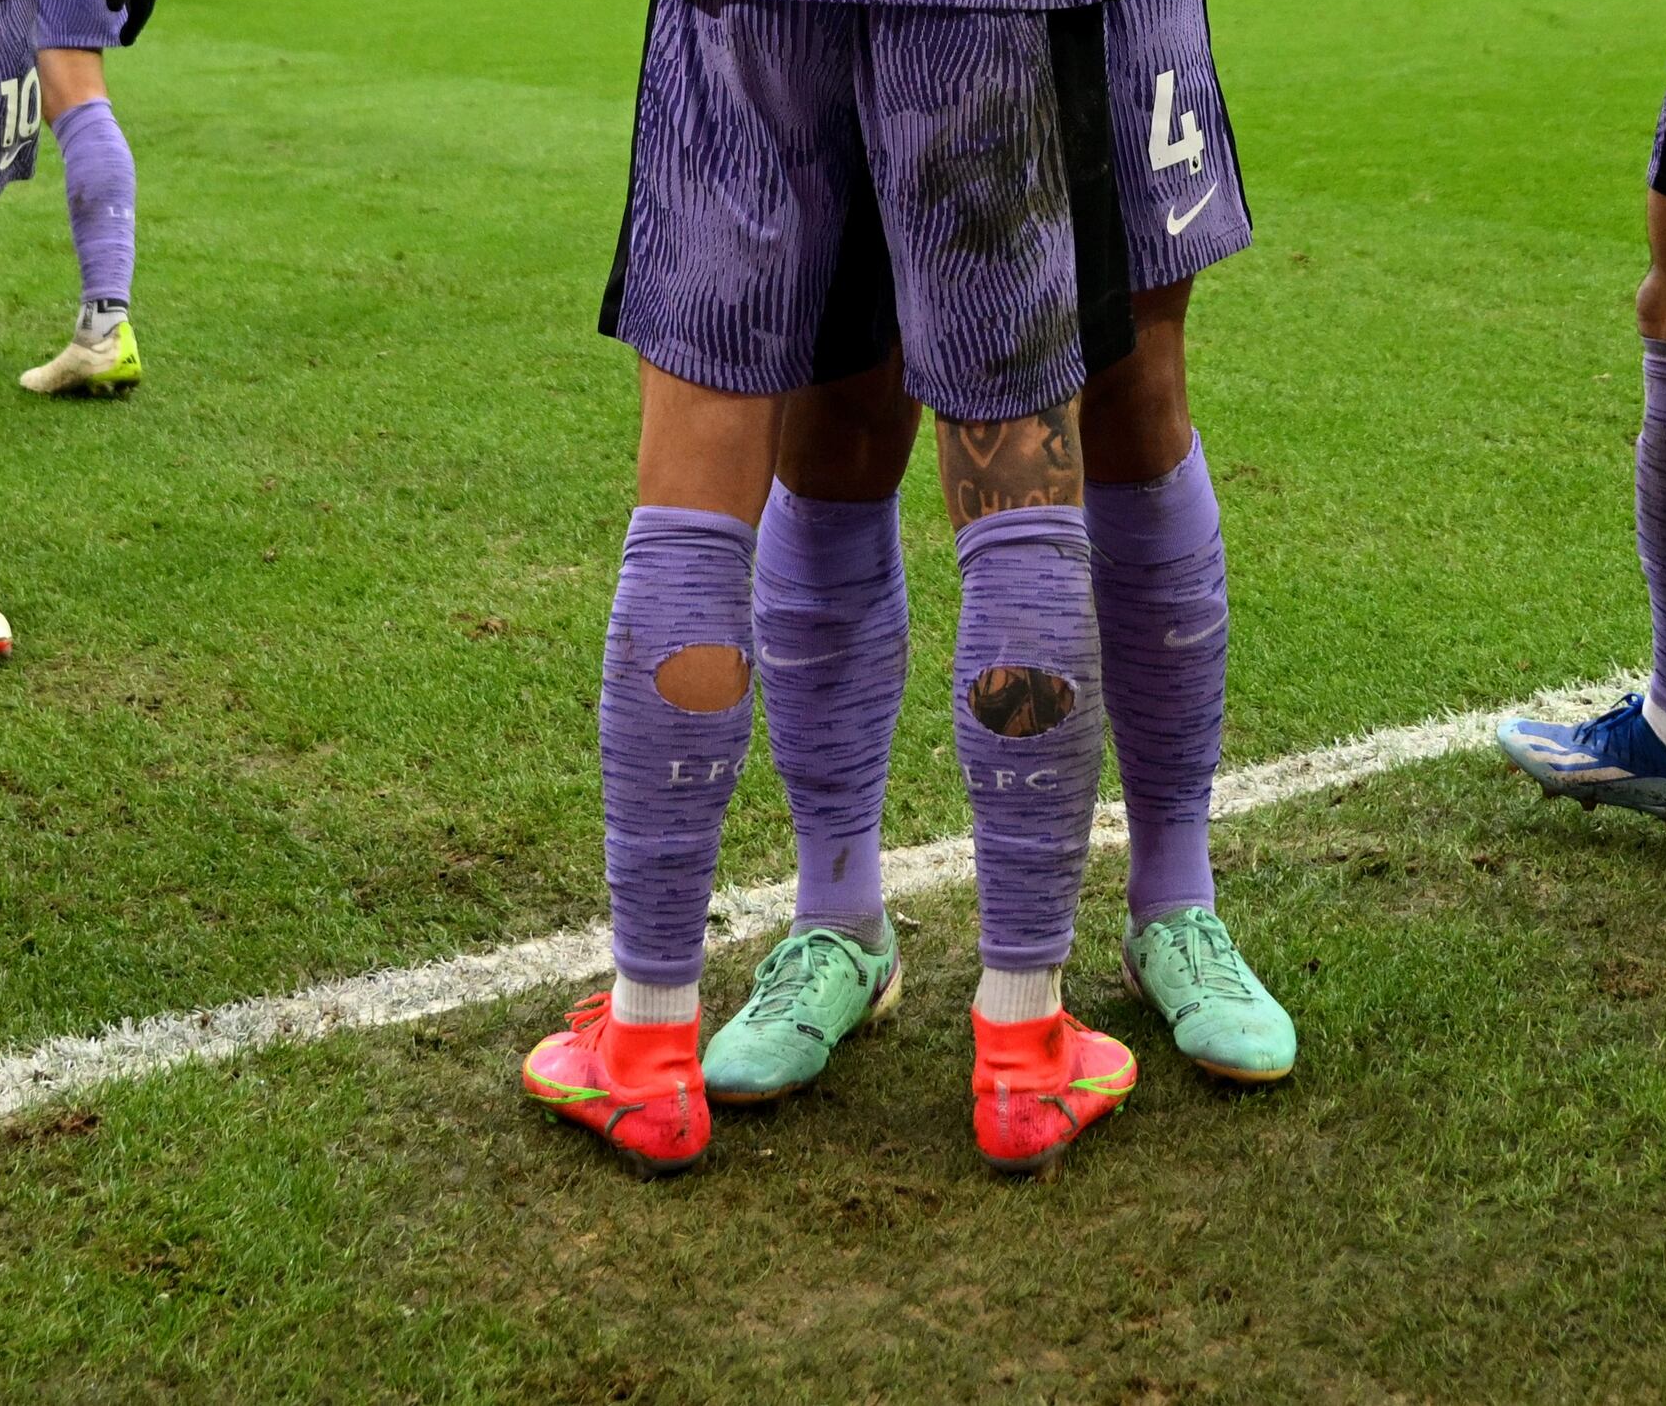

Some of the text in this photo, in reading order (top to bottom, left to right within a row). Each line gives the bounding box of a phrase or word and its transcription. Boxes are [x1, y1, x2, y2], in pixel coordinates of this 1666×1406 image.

[0, 66, 42, 148] 10
[1148, 69, 1204, 176] 4
[963, 763, 1058, 791] LFC
